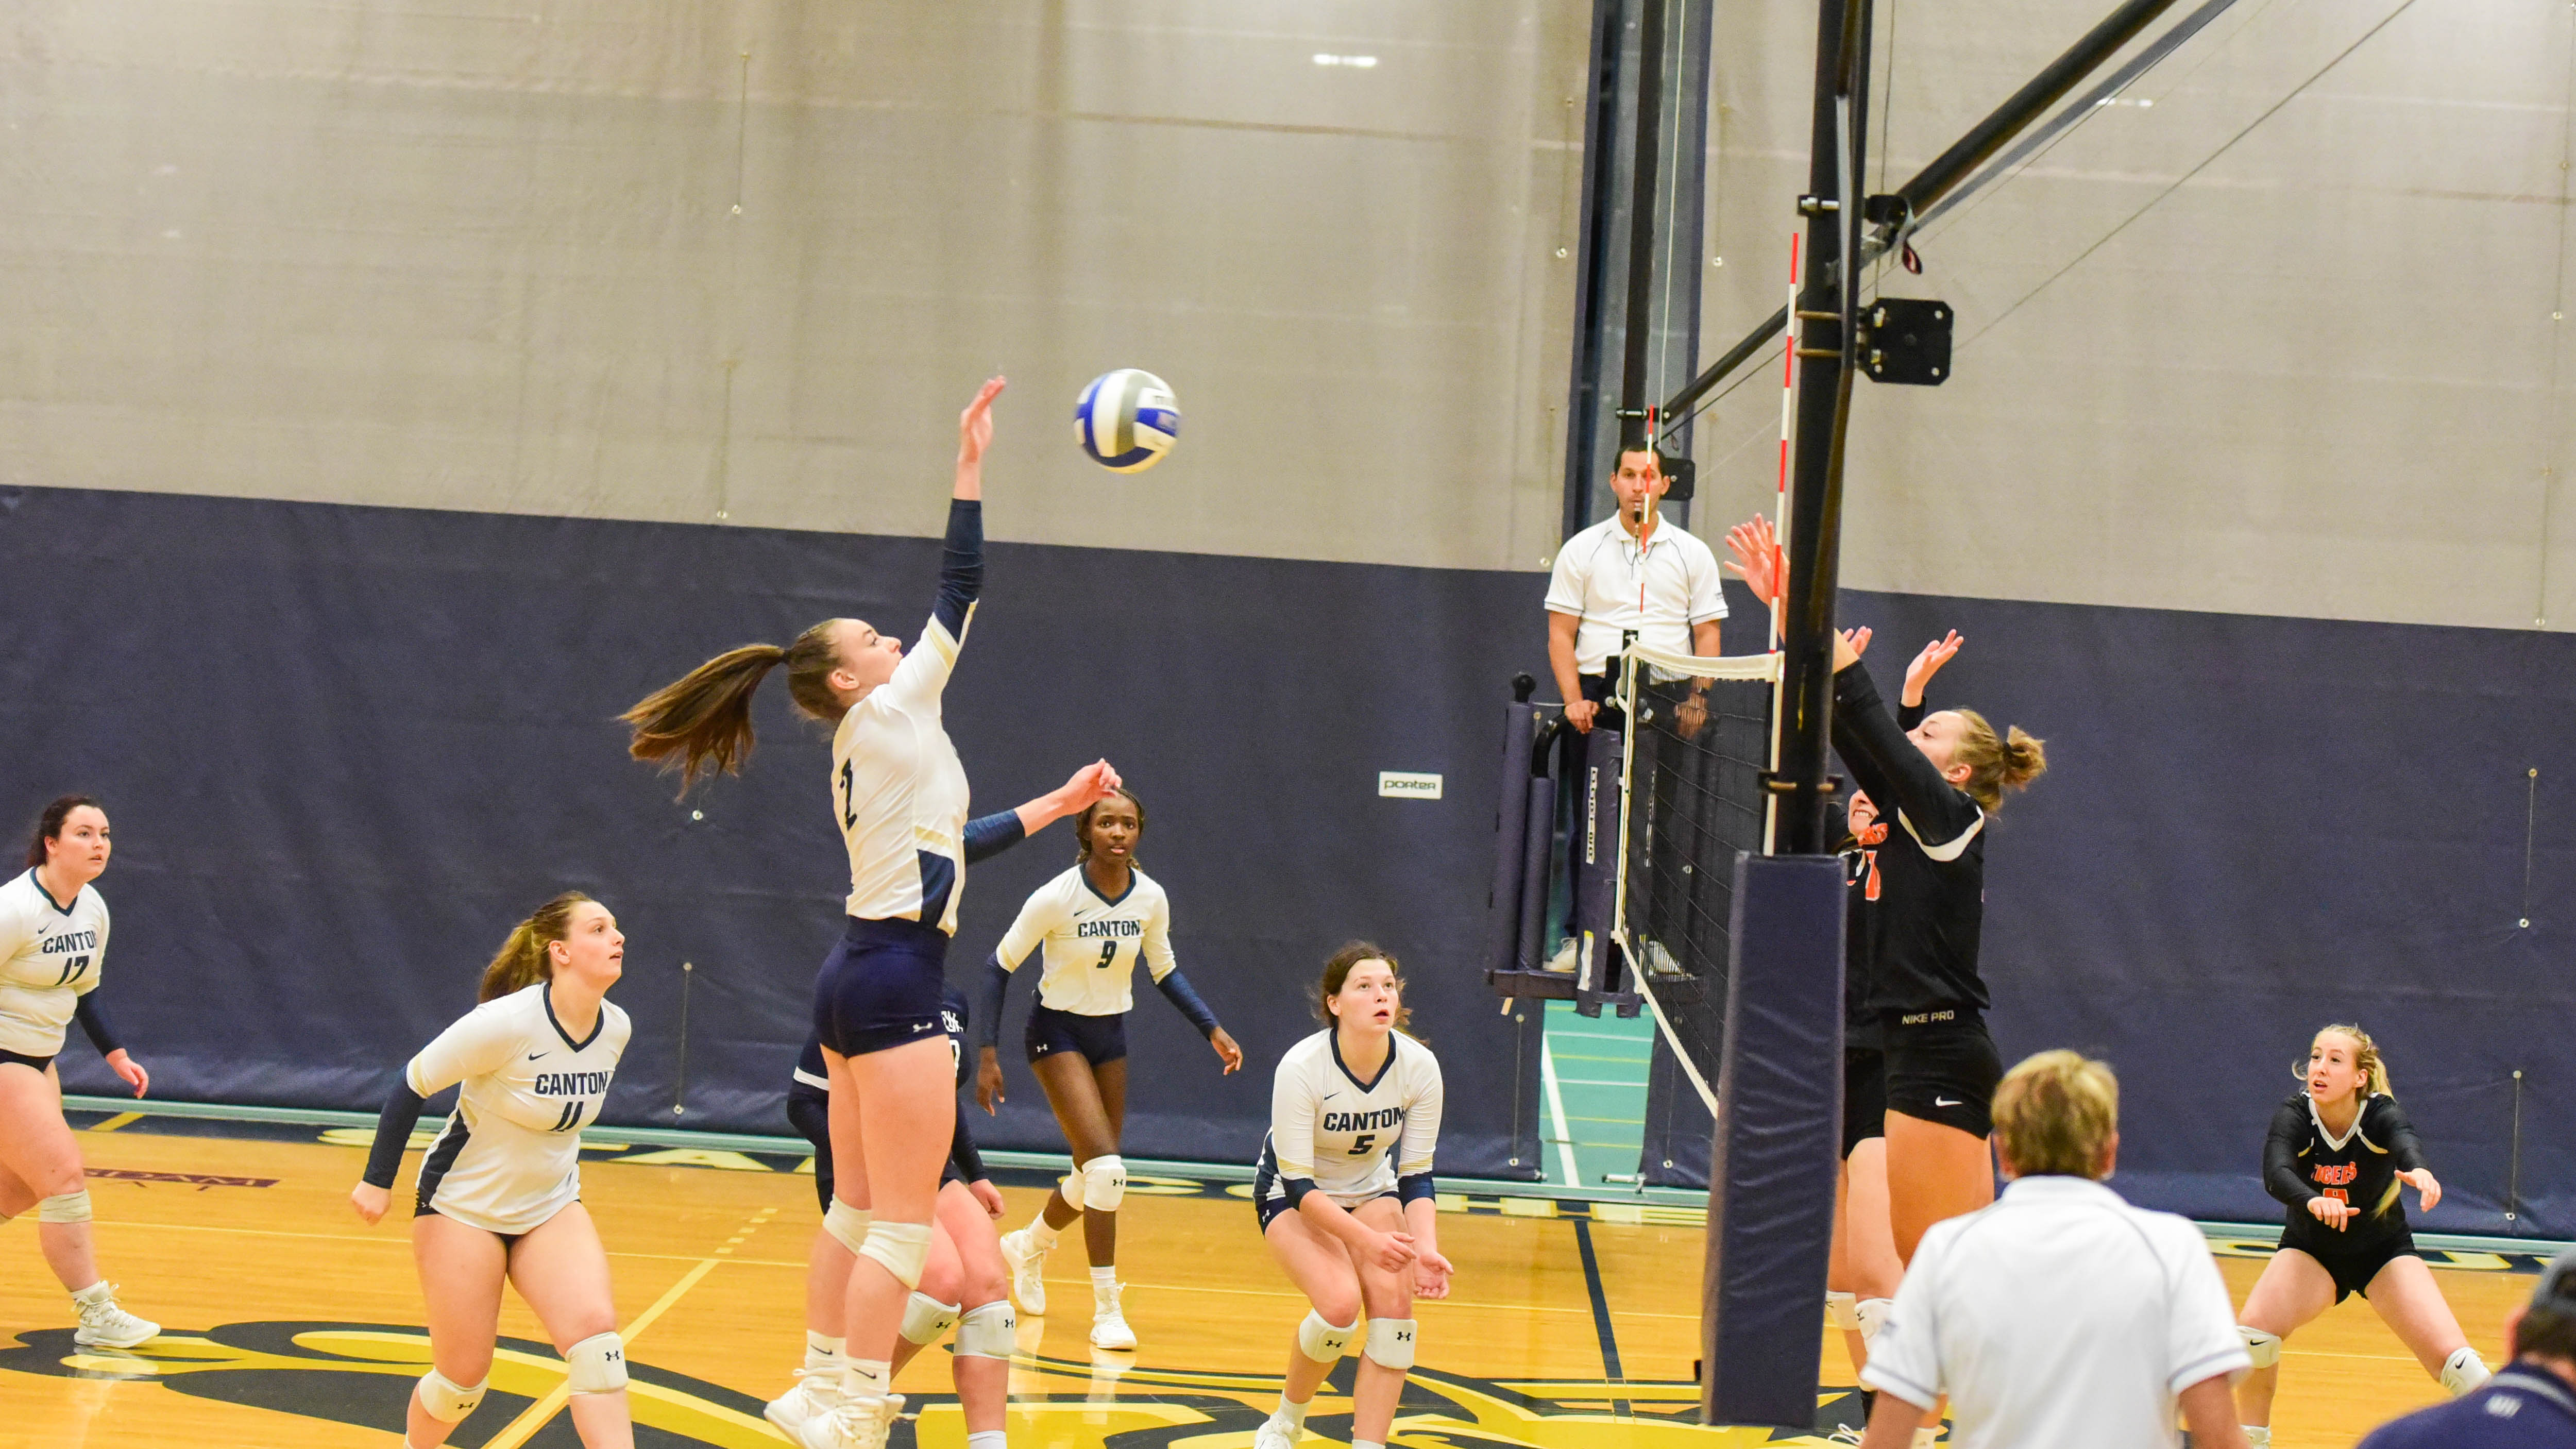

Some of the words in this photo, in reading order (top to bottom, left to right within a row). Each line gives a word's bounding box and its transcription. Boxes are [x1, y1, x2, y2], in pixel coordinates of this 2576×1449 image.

[1078, 920, 1140, 937] CANTON
[1096, 940, 1117, 969] 9
[54, 955, 90, 986] 17
[1902, 1013, 1928, 1025] NIKE
[1930, 1009, 1954, 1022] PRO
[535, 1072, 608, 1095] CANTON
[547, 1101, 584, 1132] 11
[1323, 1106, 1405, 1132] CANTON
[1348, 1134, 1376, 1155] 5
